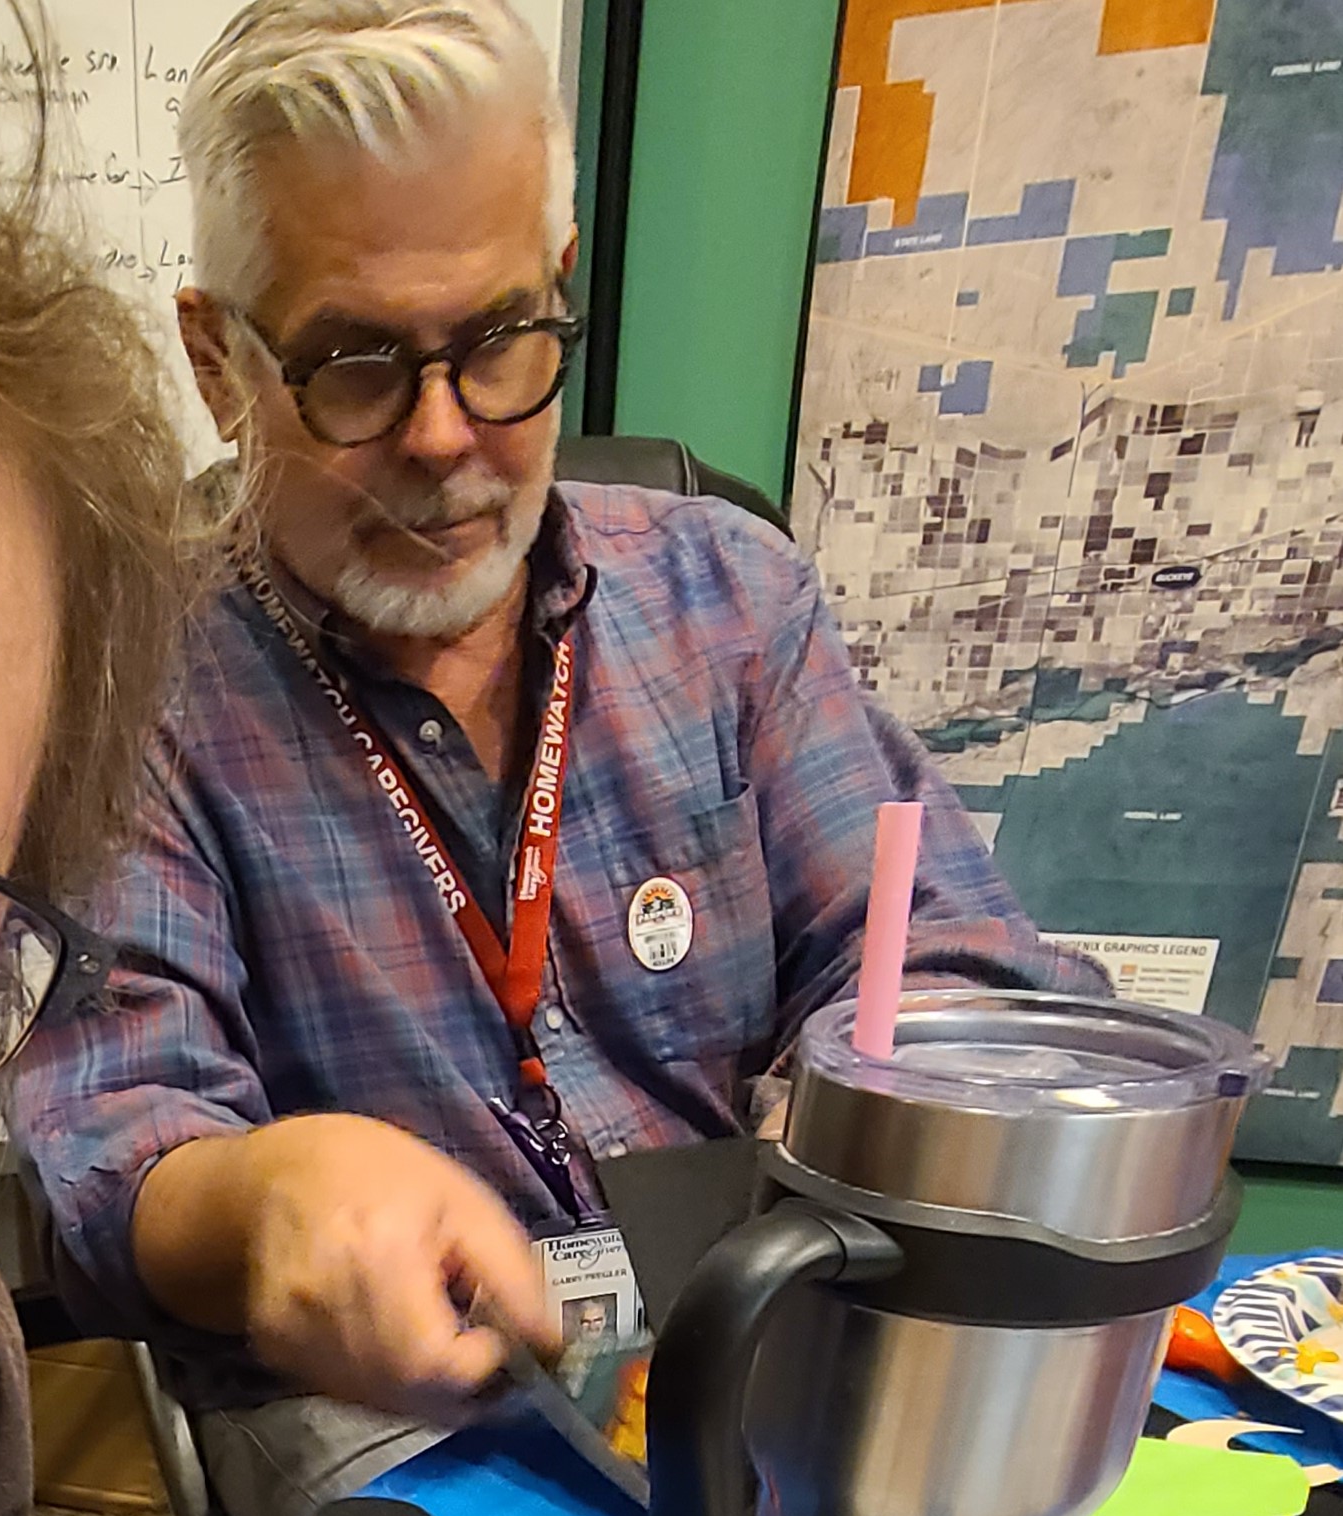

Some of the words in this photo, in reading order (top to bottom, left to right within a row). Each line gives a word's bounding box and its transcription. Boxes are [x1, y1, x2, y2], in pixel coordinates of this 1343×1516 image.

[529, 641, 570, 837] HOMEWATCH
[1104, 942, 1159, 955] GRAPHICS
[1162, 944, 1208, 956] LEGEND
